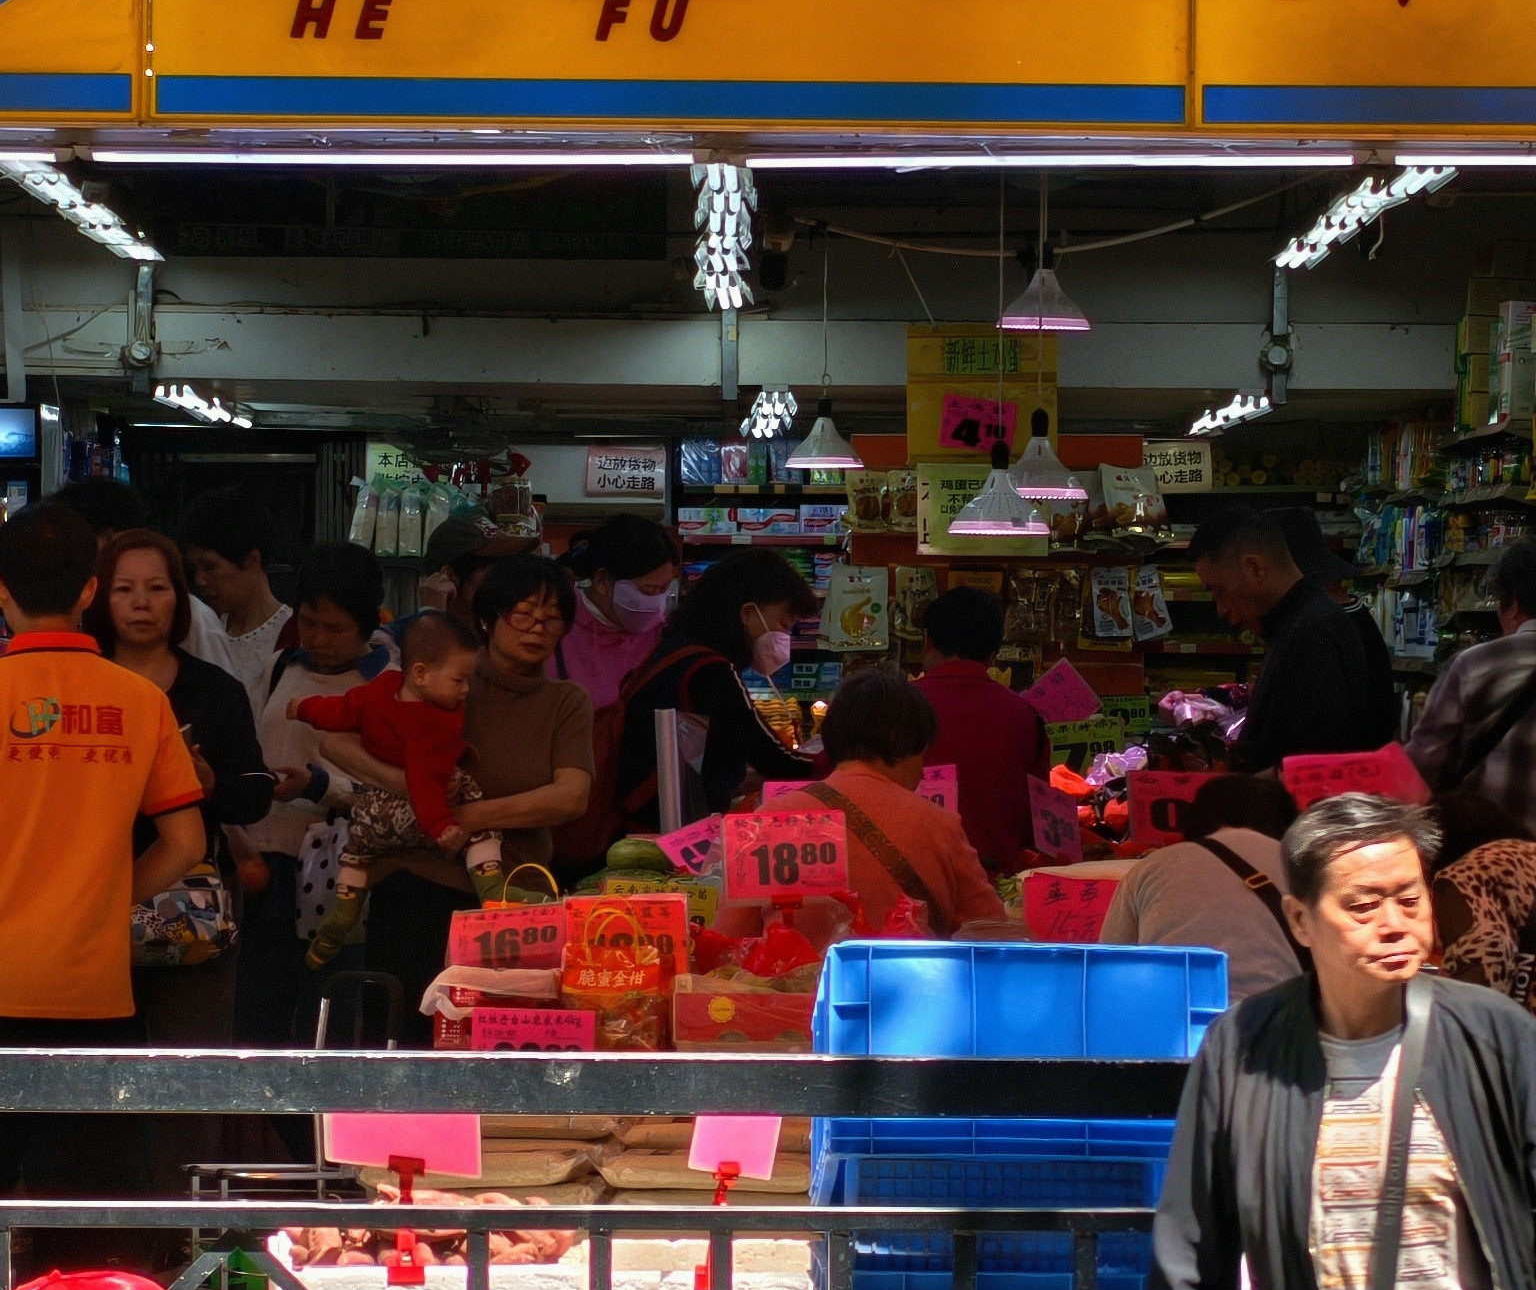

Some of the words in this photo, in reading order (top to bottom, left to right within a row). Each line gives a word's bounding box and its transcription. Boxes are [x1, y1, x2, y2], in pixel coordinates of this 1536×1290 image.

[597, 474, 655, 490] 小心走路
[1155, 469, 1203, 484] 心走路
[940, 479, 983, 491] 鸡蛋已
[61, 704, 124, 736] 和富
[578, 969, 646, 988] 脆蜜金柑
